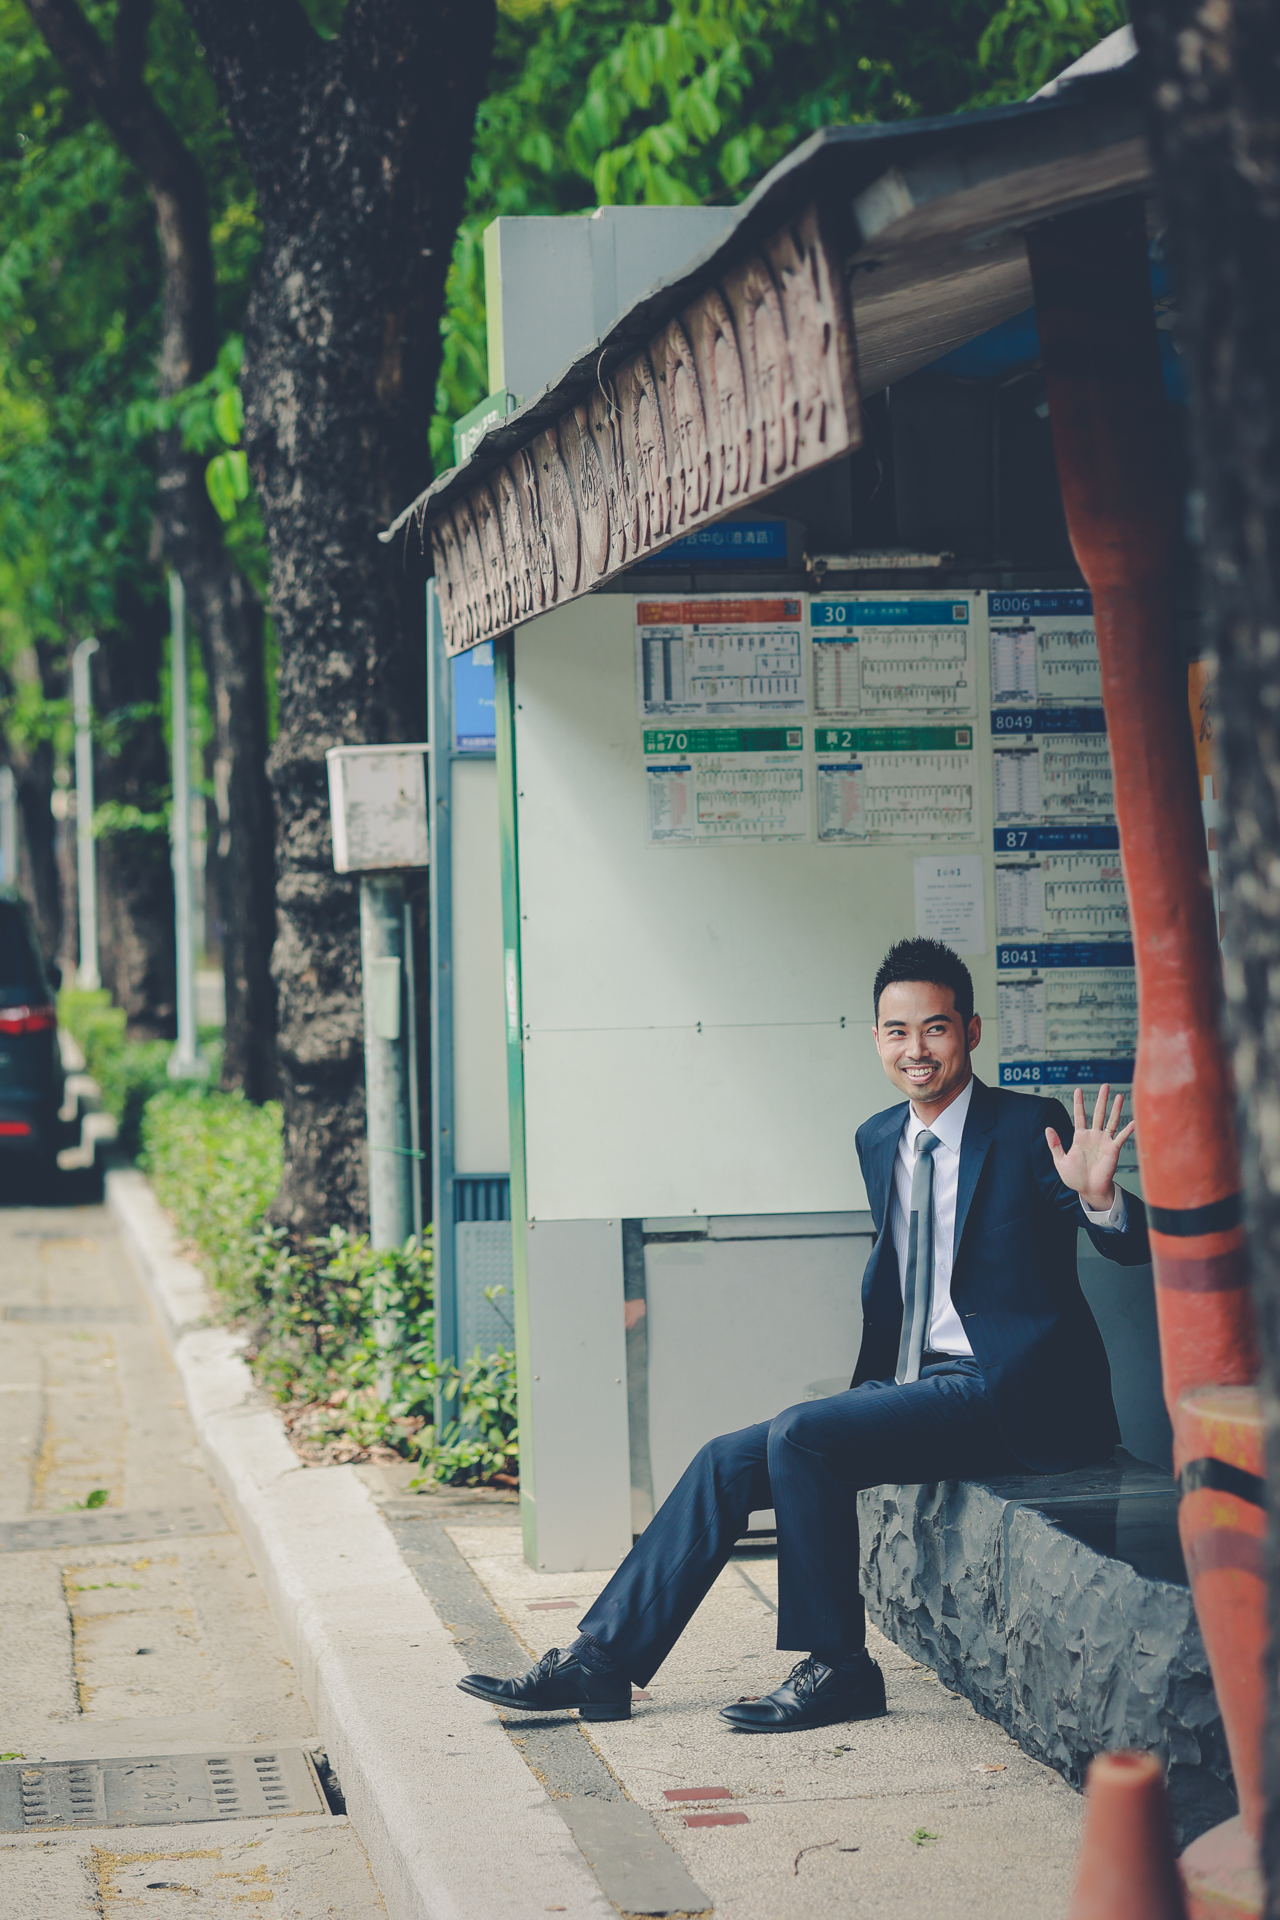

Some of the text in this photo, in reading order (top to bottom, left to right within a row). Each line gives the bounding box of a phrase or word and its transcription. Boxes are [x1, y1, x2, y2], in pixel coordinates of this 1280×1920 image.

[992, 597, 1030, 612] 8006
[825, 606, 846, 623] 30
[995, 715, 1032, 729] 8049
[665, 733, 687, 750] 70
[1006, 831, 1028, 847] 87
[1001, 950, 1037, 964] 8041
[1003, 1067, 1041, 1081] 8048
